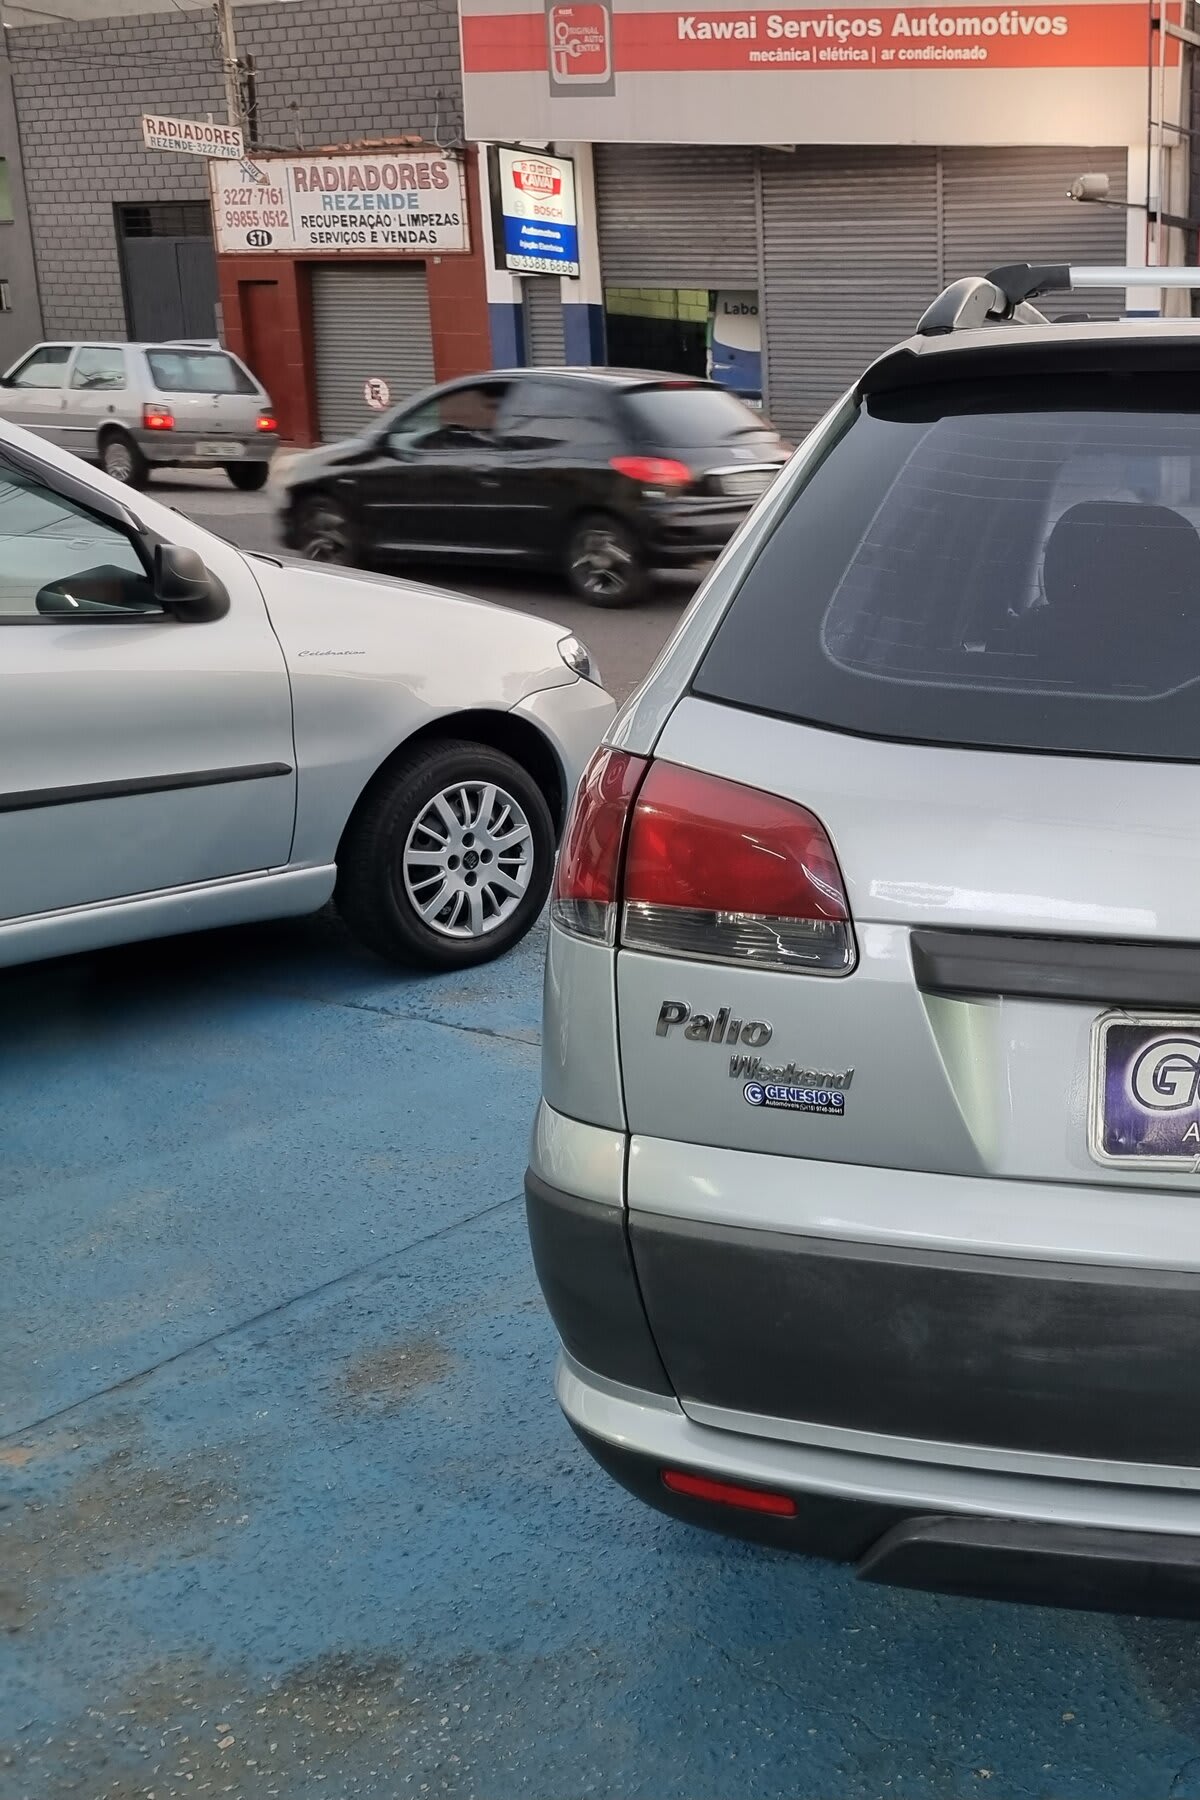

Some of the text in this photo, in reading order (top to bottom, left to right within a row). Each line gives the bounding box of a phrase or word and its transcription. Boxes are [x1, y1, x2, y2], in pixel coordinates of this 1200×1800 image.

[676, 10, 1069, 43] Kawai Serviços Automotivos
[749, 45, 988, 62] mecânica elétrica ar condicionado
[145, 118, 241, 147] RADIADORES
[293, 161, 450, 192] RADIADORES
[521, 172, 554, 189] KAWAI
[321, 192, 420, 211] REZENDE
[533, 204, 563, 218] BOSCH
[398, 212, 460, 228] LIMPEZAS
[310, 230, 438, 245] SERVIÇOS E VENDAS
[724, 302, 759, 315] Labo
[655, 999, 773, 1048] Palio
[728, 1054, 855, 1091] Weekend
[765, 1084, 844, 1107] GENESIO'S
